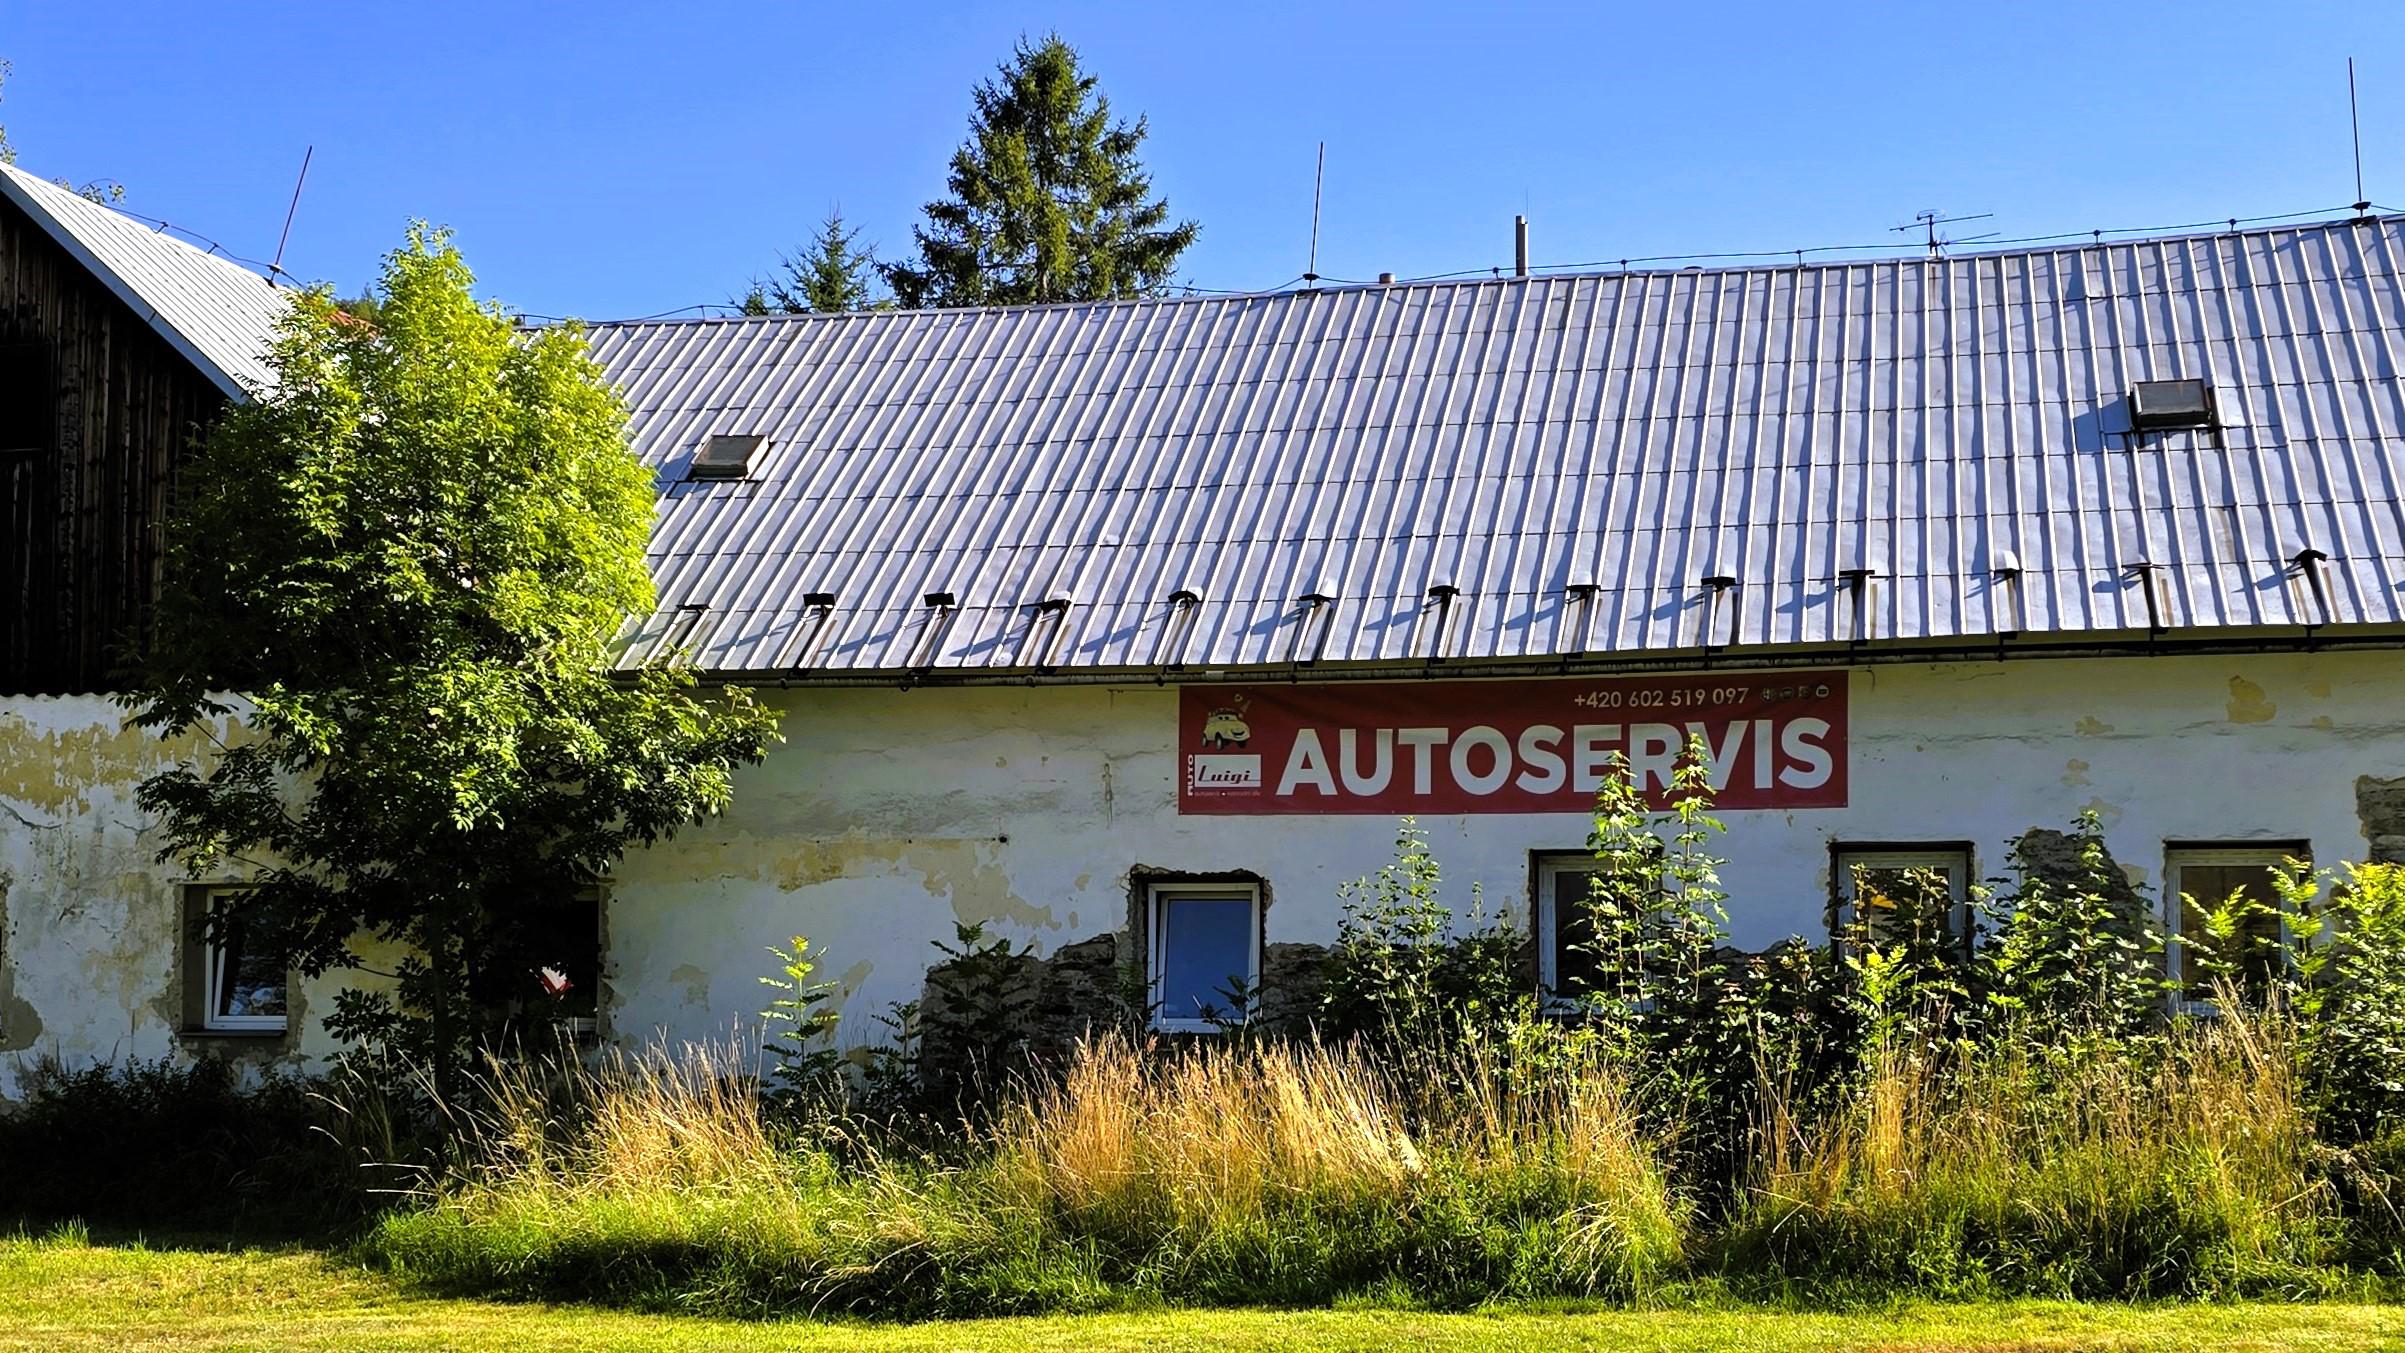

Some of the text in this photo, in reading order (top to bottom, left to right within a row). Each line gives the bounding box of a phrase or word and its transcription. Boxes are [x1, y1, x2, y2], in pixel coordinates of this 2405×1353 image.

[1574, 688, 1749, 708] +420 602 519 097
[1275, 717, 1834, 797] AUTOSERVIS
[1198, 764, 1251, 785] Luigi
